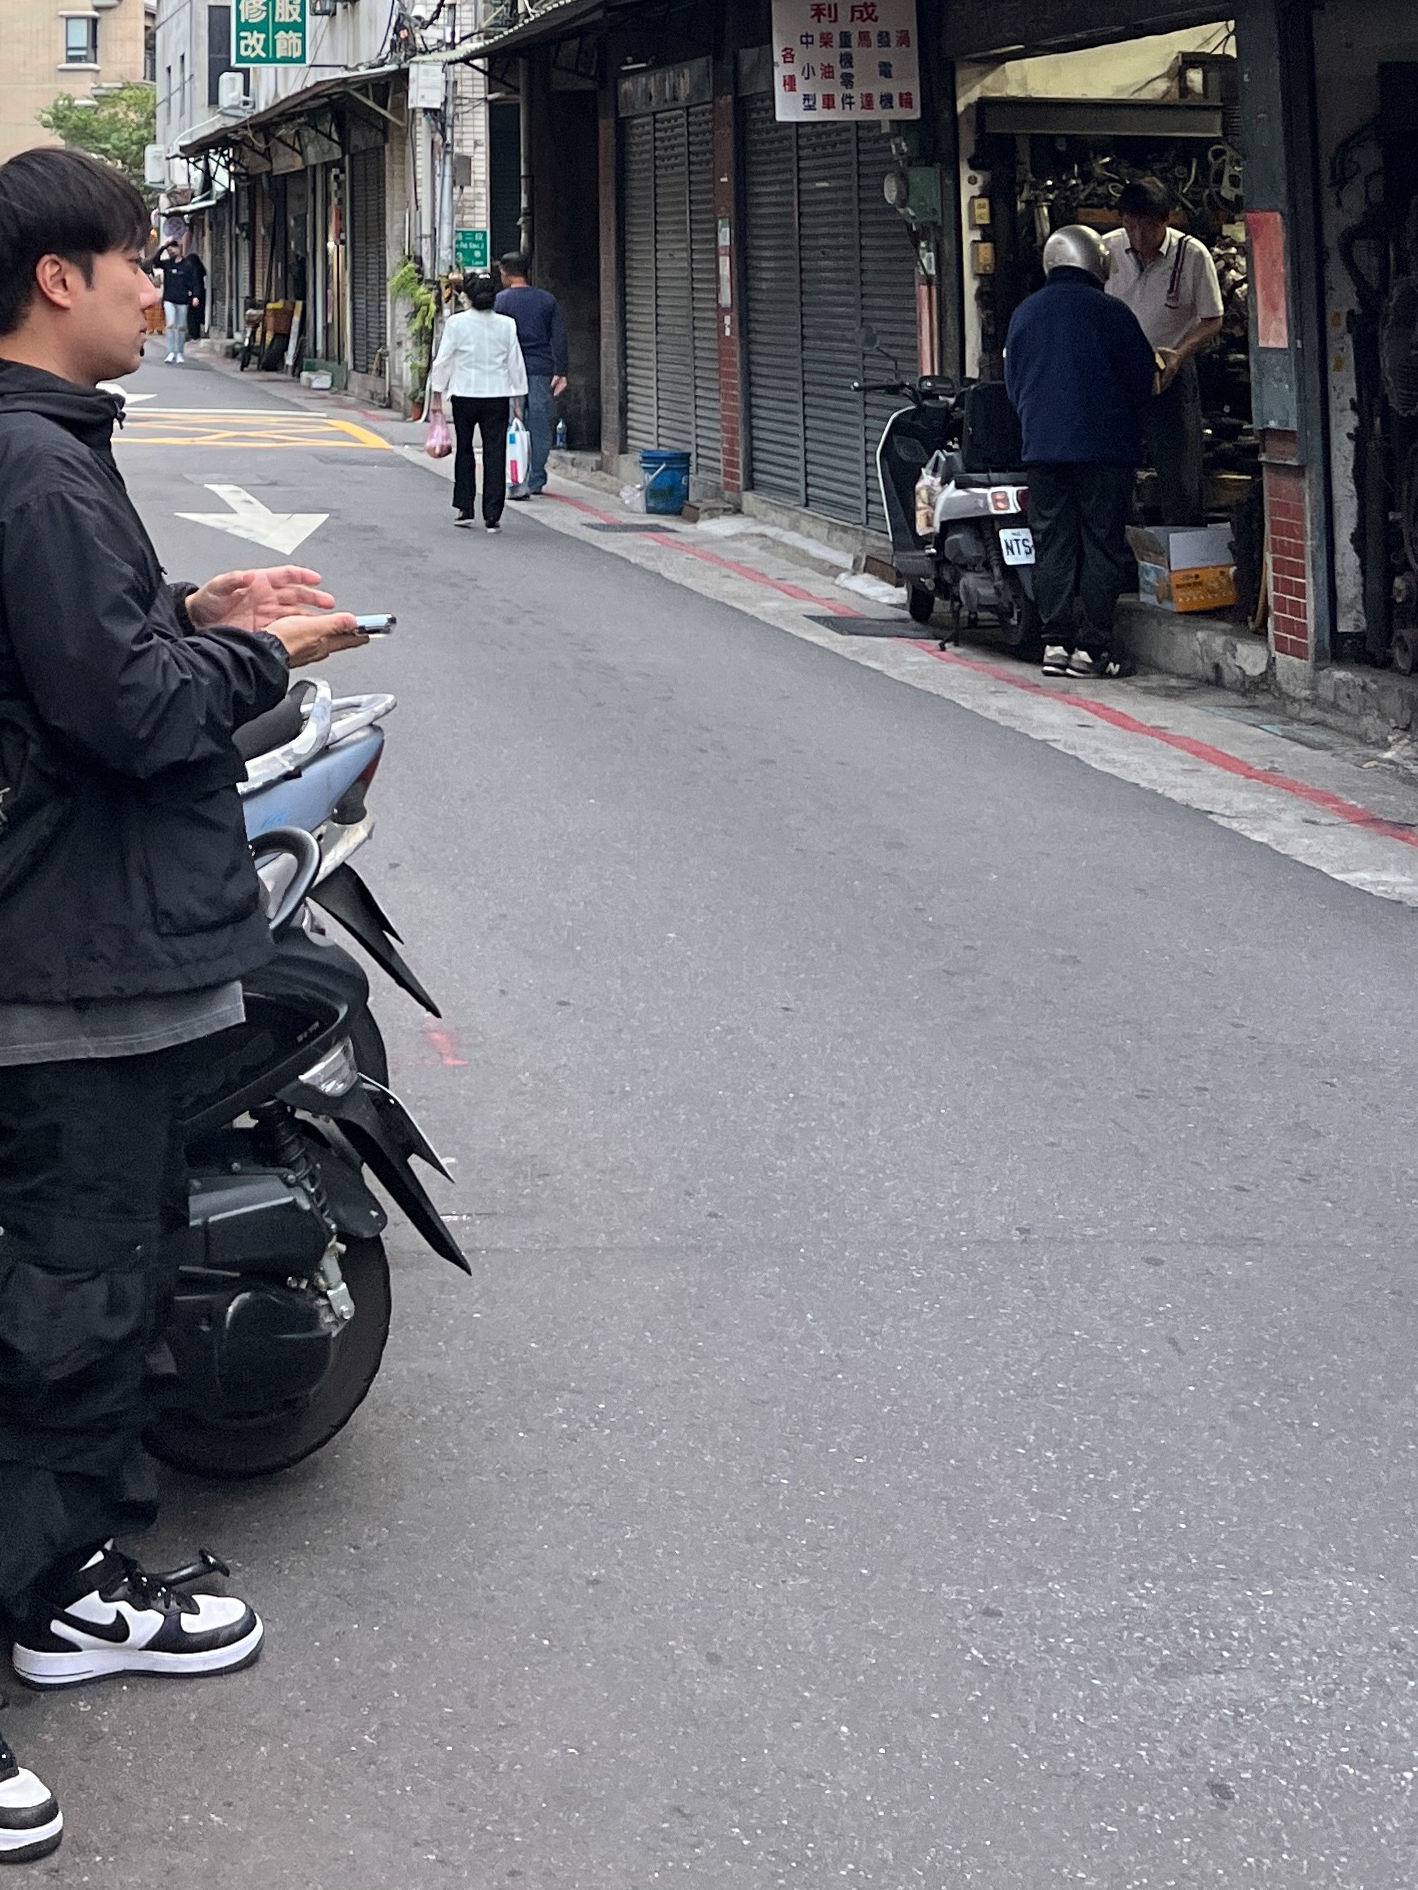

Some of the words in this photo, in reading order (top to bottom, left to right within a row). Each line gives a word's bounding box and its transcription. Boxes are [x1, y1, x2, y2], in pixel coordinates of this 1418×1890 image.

[781, 47, 797, 92] 各種
[800, 32, 817, 111] 中小型
